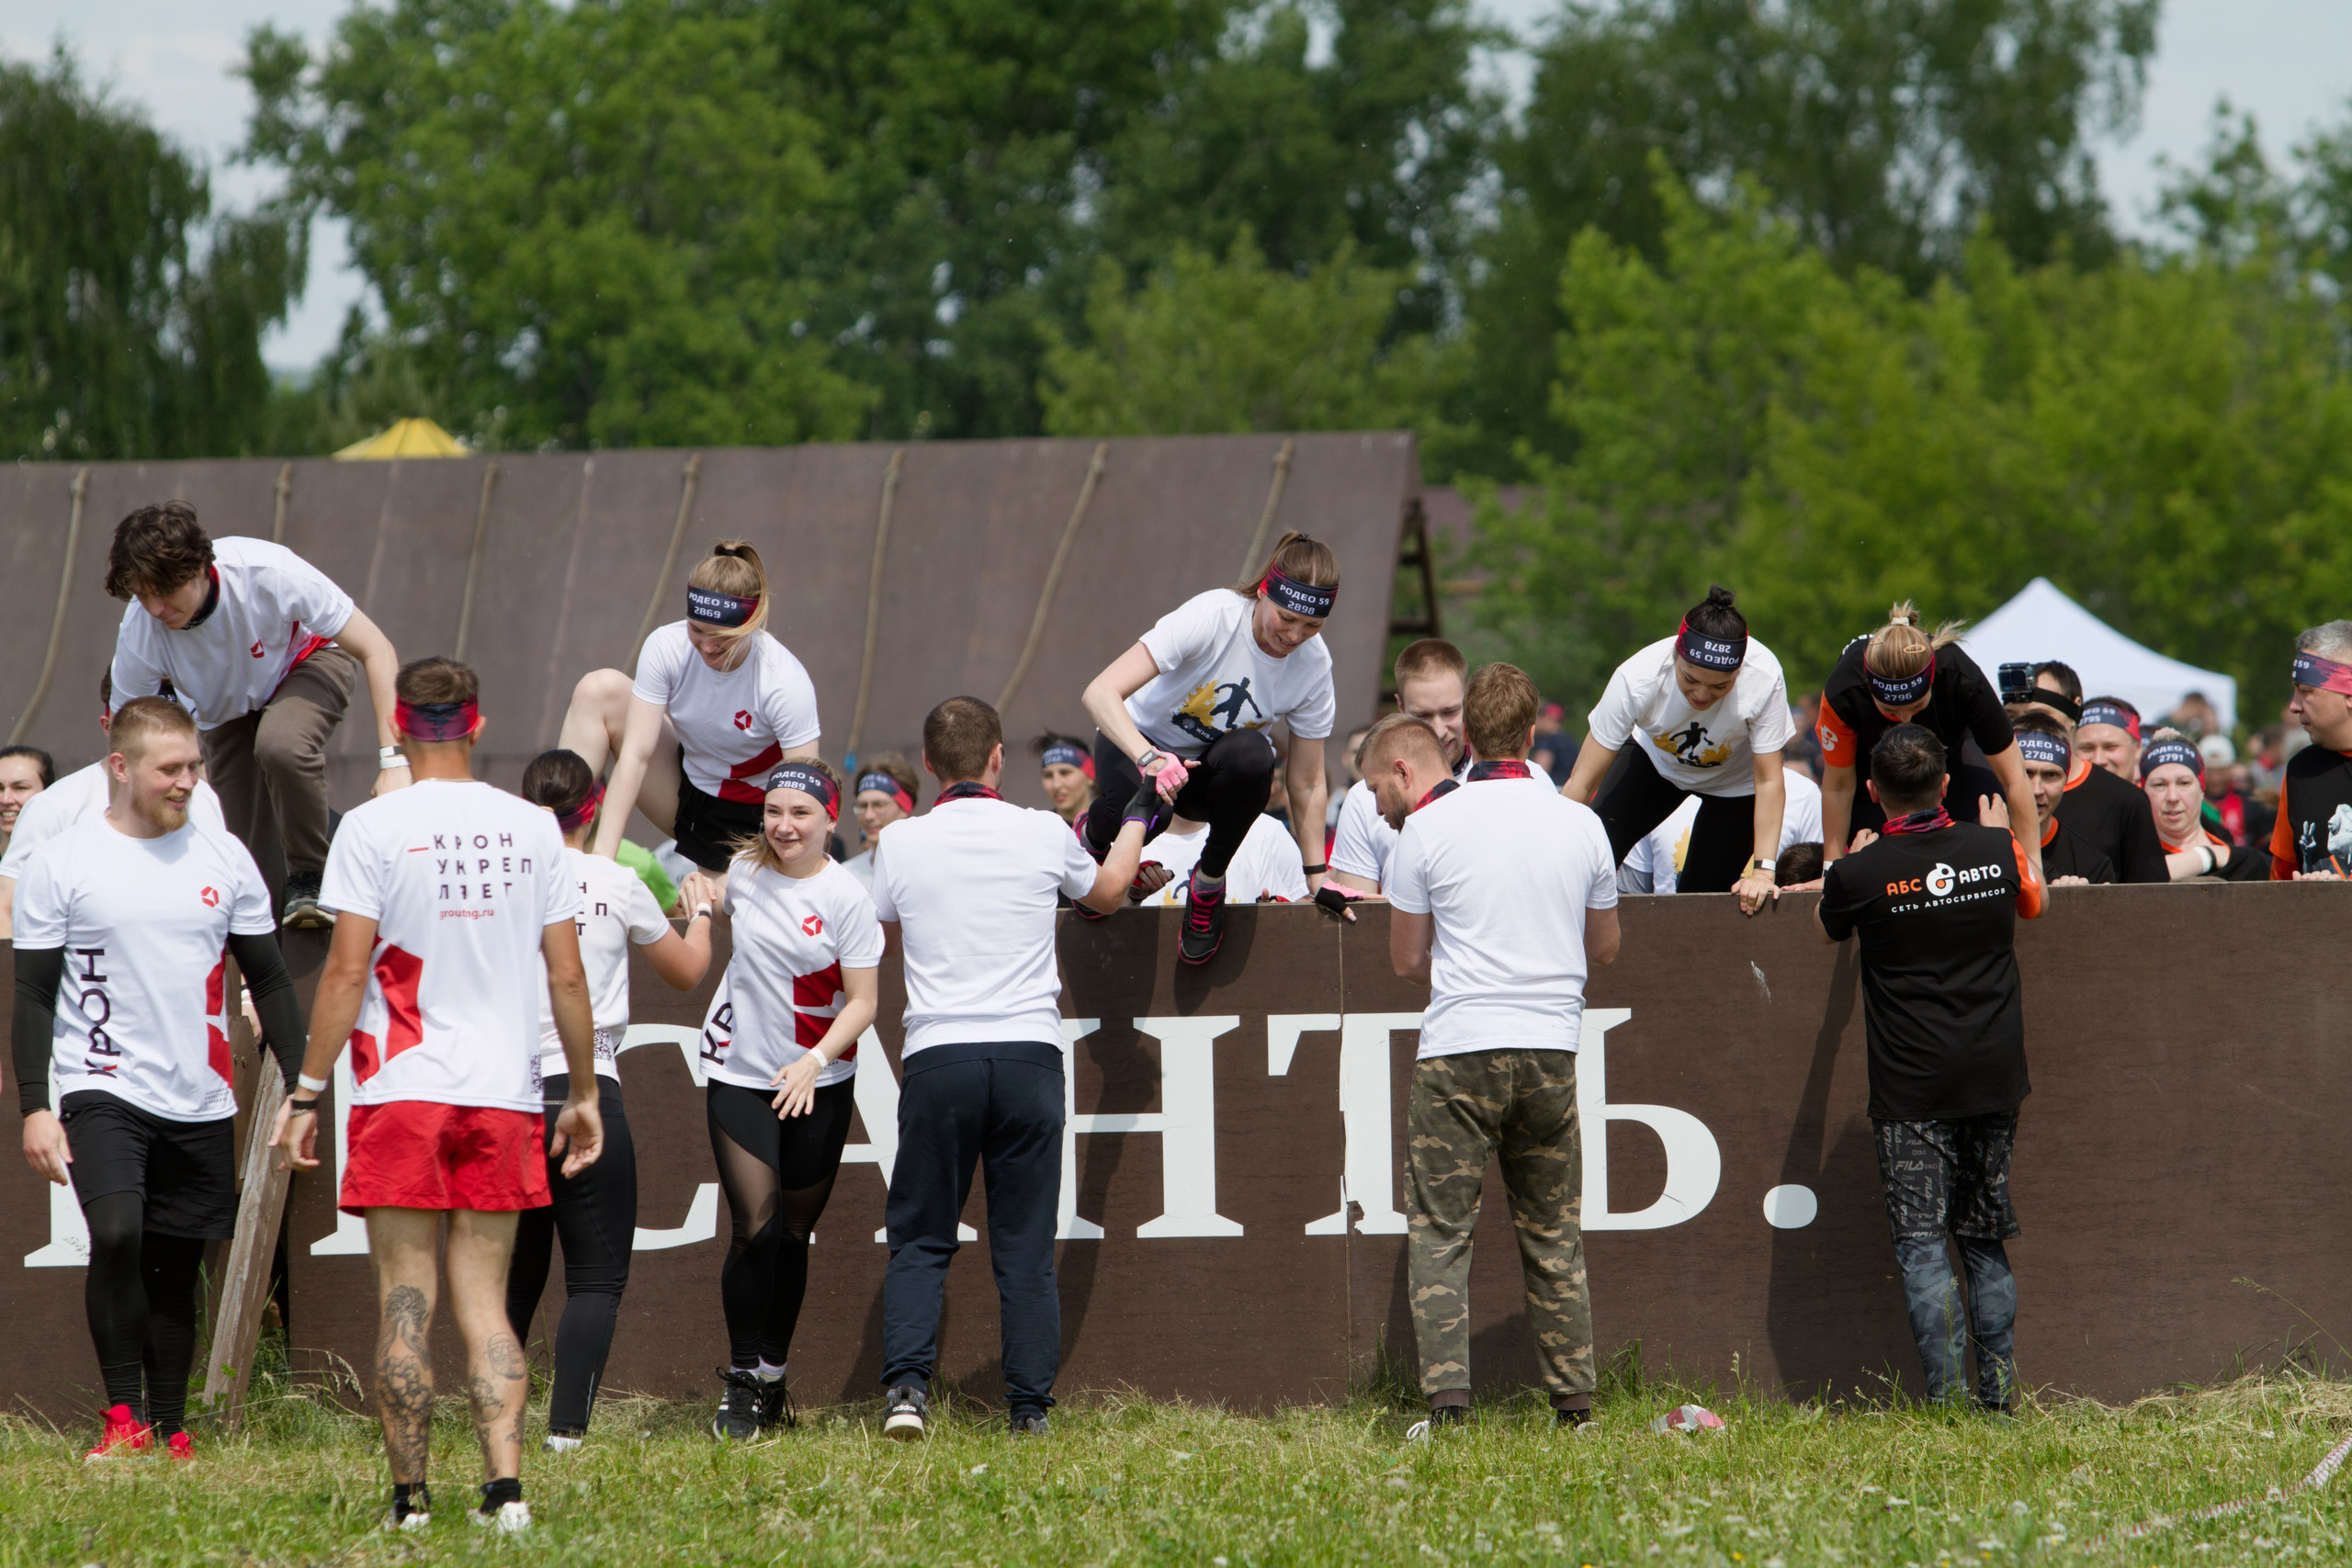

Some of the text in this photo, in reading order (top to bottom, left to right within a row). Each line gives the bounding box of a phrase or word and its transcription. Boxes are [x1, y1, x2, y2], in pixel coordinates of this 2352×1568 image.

[689, 592, 737, 610] РОДЕО 59
[1279, 584, 1329, 606] РОДЕО 59
[695, 606, 720, 619] 2869
[1288, 601, 1316, 615] 2898
[1704, 641, 1731, 653] 2878
[1690, 649, 1740, 665] РОДЕО 59
[2298, 660, 2310, 670] 59
[1872, 676, 1922, 692] РОДЕО 59
[1884, 693, 1913, 702] 2796
[2018, 739, 2065, 754] ОДЕО 59
[2148, 745, 2196, 760] РОДЕО 59
[2025, 750, 2054, 761] 2788
[2159, 753, 2183, 762] 2791
[777, 781, 807, 791] 2889
[808, 775, 821, 786] 59
[1886, 863, 2001, 897] АБС АВТО
[1891, 887, 2007, 913] СЕТЬ АВТОСЕРВИСОВ
[1894, 1160, 1924, 1171] FILA
[893, 1404, 917, 1413] adidas
